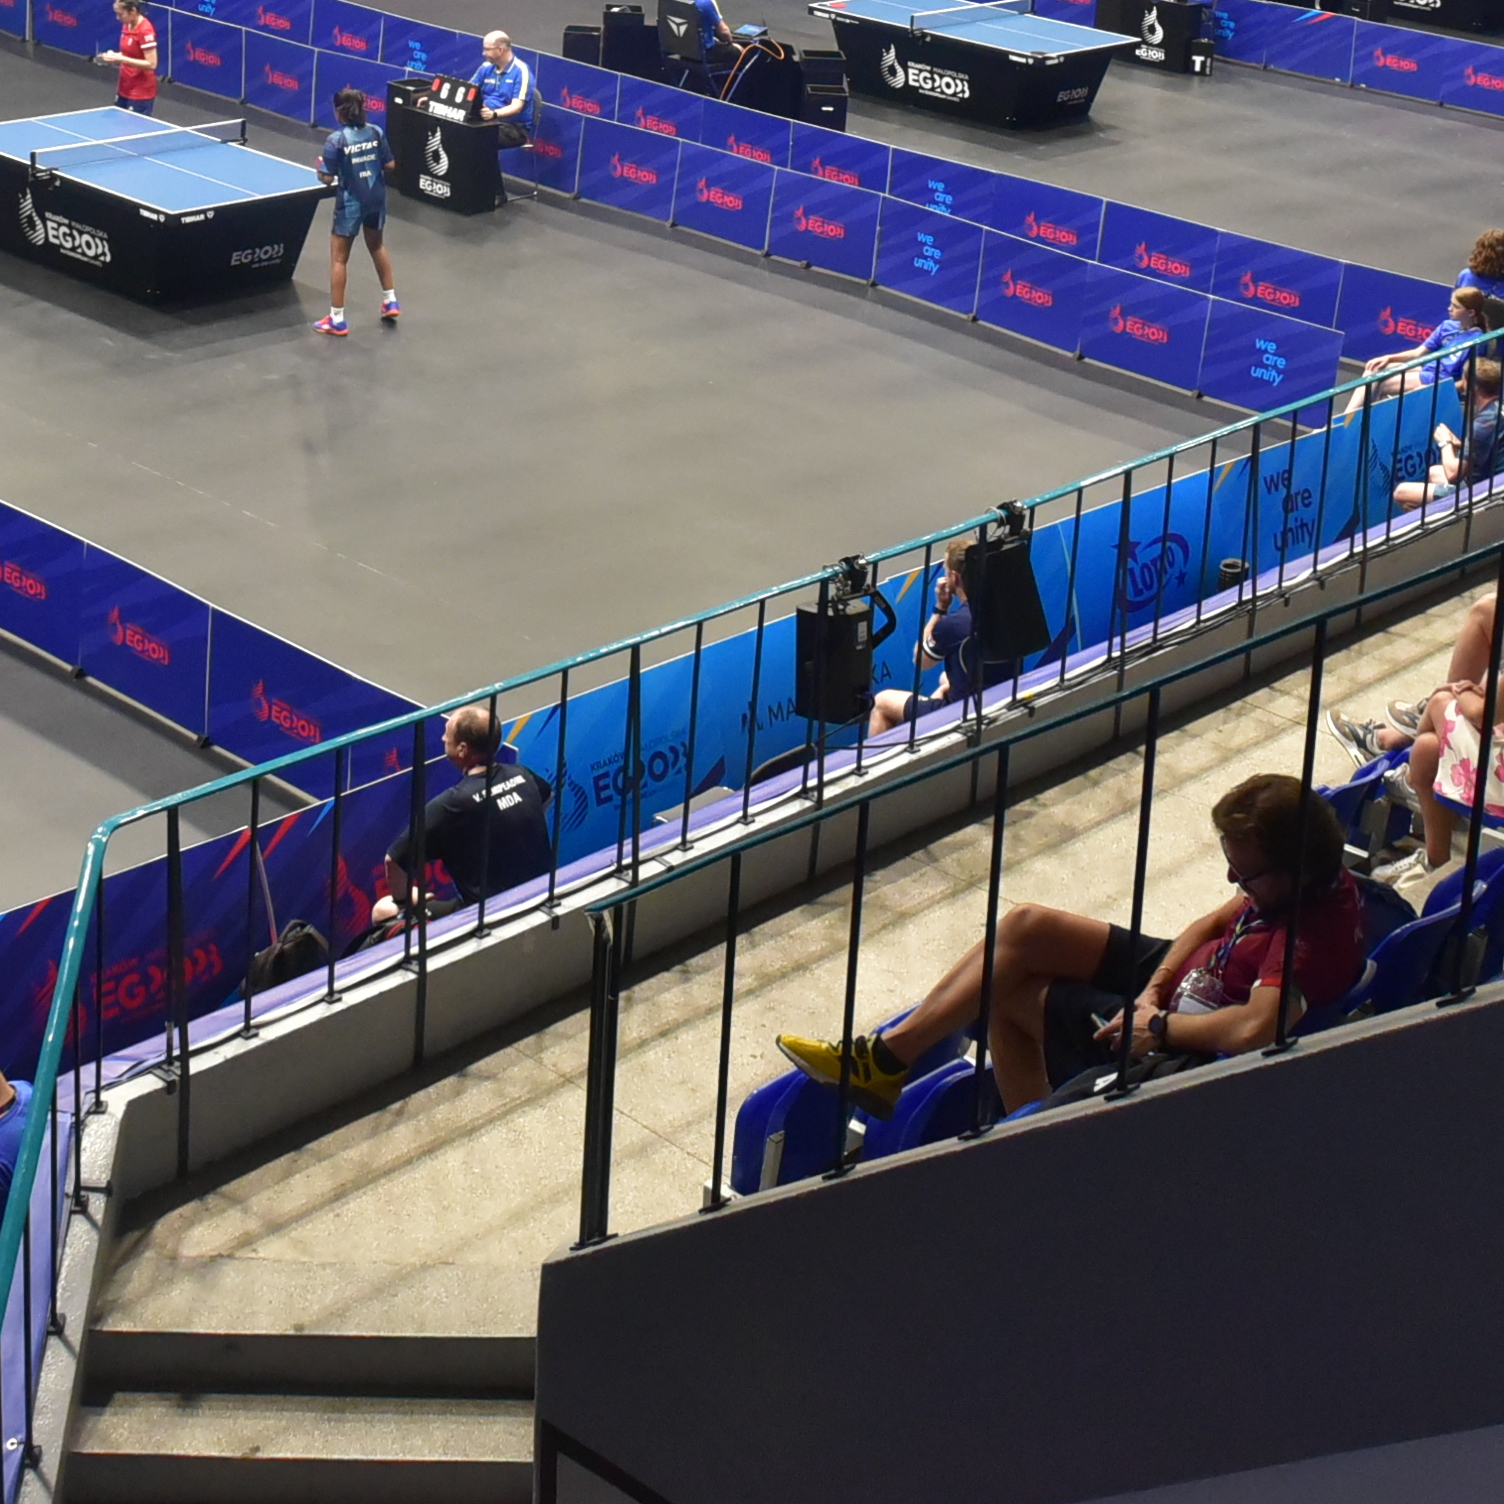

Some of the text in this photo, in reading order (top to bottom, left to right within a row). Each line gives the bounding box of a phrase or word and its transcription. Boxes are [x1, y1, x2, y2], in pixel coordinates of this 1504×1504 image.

[198, 3, 216, 16] unity
[440, 82, 465, 103] 6 6
[908, 70, 970, 98] EG2023
[344, 140, 378, 155] VICTAS
[623, 165, 658, 184] EG2023
[419, 178, 451, 197] EG2023
[928, 180, 945, 192] we
[709, 190, 742, 210] EG2023
[934, 191, 952, 205] are
[926, 204, 951, 215] unity
[808, 219, 845, 239] EG2023
[917, 231, 934, 245] we
[1039, 223, 1077, 246] EG2023
[46, 225, 112, 264] EG2023
[230, 243, 284, 266] EG2023
[923, 245, 942, 259] are
[913, 256, 939, 275] unity
[1150, 254, 1190, 278] EG2023
[1015, 282, 1053, 307] EG2023
[1256, 284, 1300, 308] EG2023
[1126, 320, 1169, 344] EG2023
[1255, 338, 1277, 354] we
[1262, 353, 1286, 369] are
[1250, 366, 1284, 386] unity
[1263, 469, 1292, 494] we
[1282, 491, 1312, 514] are
[1273, 516, 1316, 553] unity
[5, 566, 47, 599] EG2023
[126, 631, 170, 664] EG2023
[272, 705, 320, 742] EG2023
[496, 792, 523, 811] MDA
